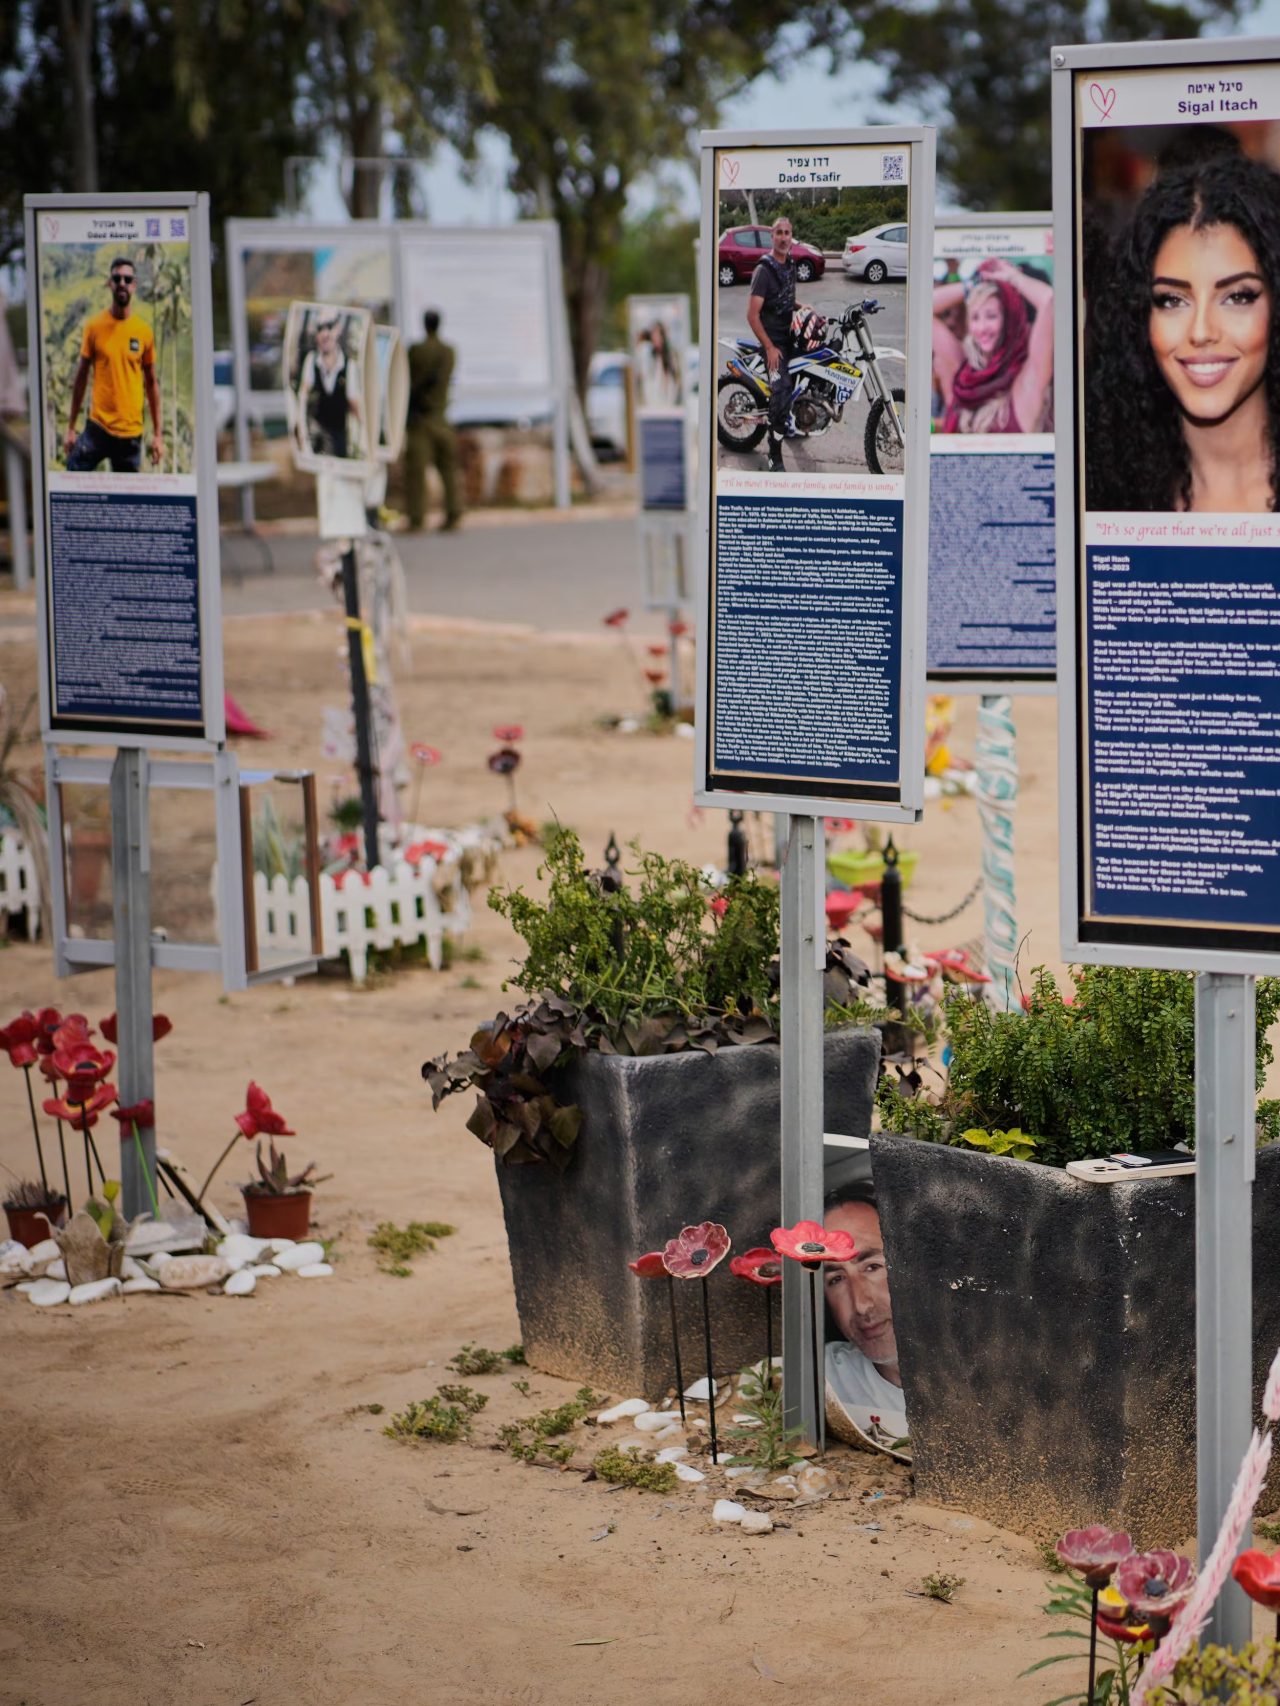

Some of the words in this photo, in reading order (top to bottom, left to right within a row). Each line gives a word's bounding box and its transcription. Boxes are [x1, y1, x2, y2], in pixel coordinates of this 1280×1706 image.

[1188, 84, 1215, 94] איטח
[1219, 81, 1243, 93] סיגל
[1178, 100, 1214, 116] Sigal
[1220, 98, 1258, 112] Itach
[787, 158, 810, 168] צפיר
[813, 158, 829, 167] דדו
[779, 173, 806, 183] Dado
[810, 172, 841, 182] Tsafir
[828, 482, 842, 490] and
[843, 482, 866, 493] family
[1123, 526, 1135, 536] so
[1136, 525, 1168, 541] great
[1172, 521, 1195, 536] that
[1200, 524, 1228, 536] we're
[1231, 521, 1248, 536] all
[1247, 526, 1273, 543] just
